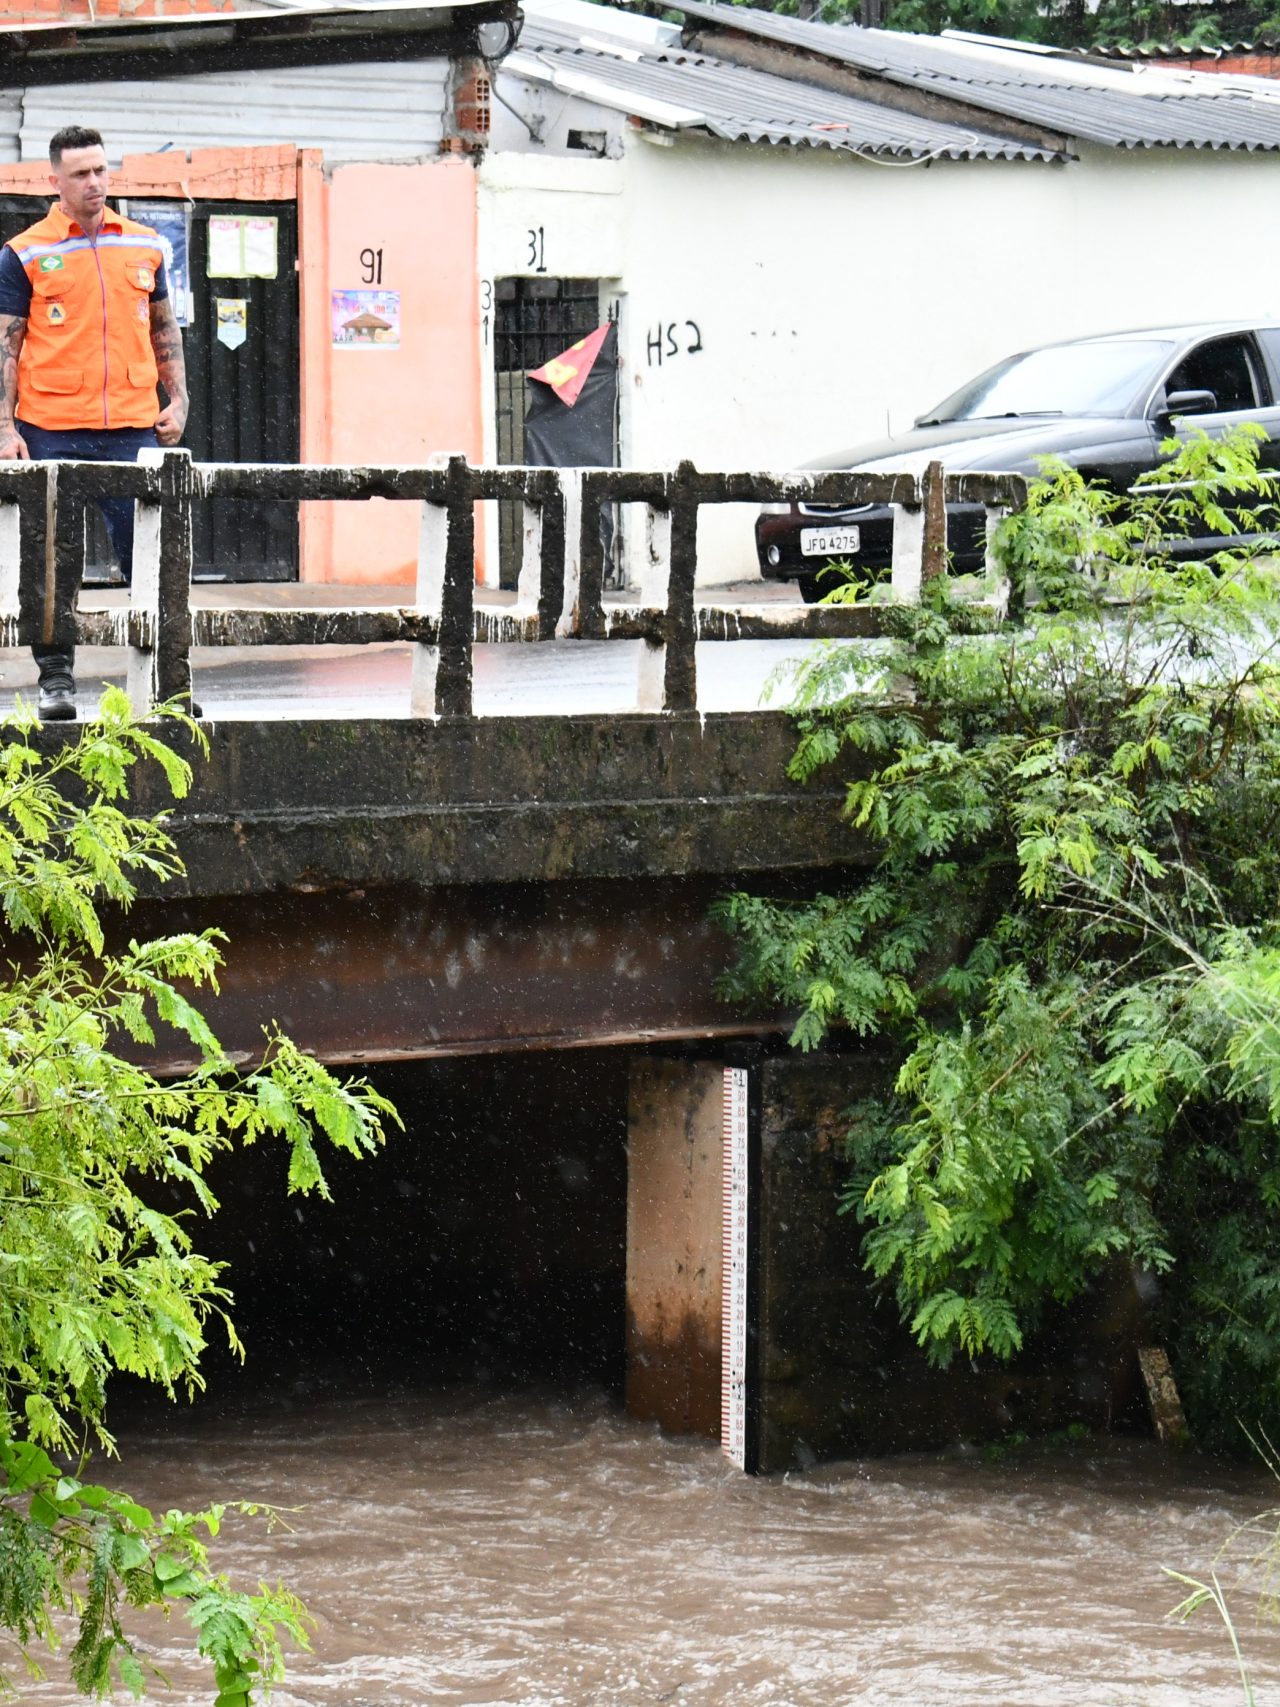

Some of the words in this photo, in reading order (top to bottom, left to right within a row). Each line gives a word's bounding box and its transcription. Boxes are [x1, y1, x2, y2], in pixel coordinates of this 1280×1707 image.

[527, 226, 547, 272] 31
[359, 247, 383, 285] 91
[646, 320, 703, 367] HS2
[829, 535, 856, 550] 4275
[737, 1137, 746, 1149] 75
[737, 1153, 746, 1165] 70
[736, 1231, 745, 1242] 45
[736, 1247, 745, 1258] 40
[736, 1325, 744, 1336] 15
[736, 1341, 744, 1352] 10
